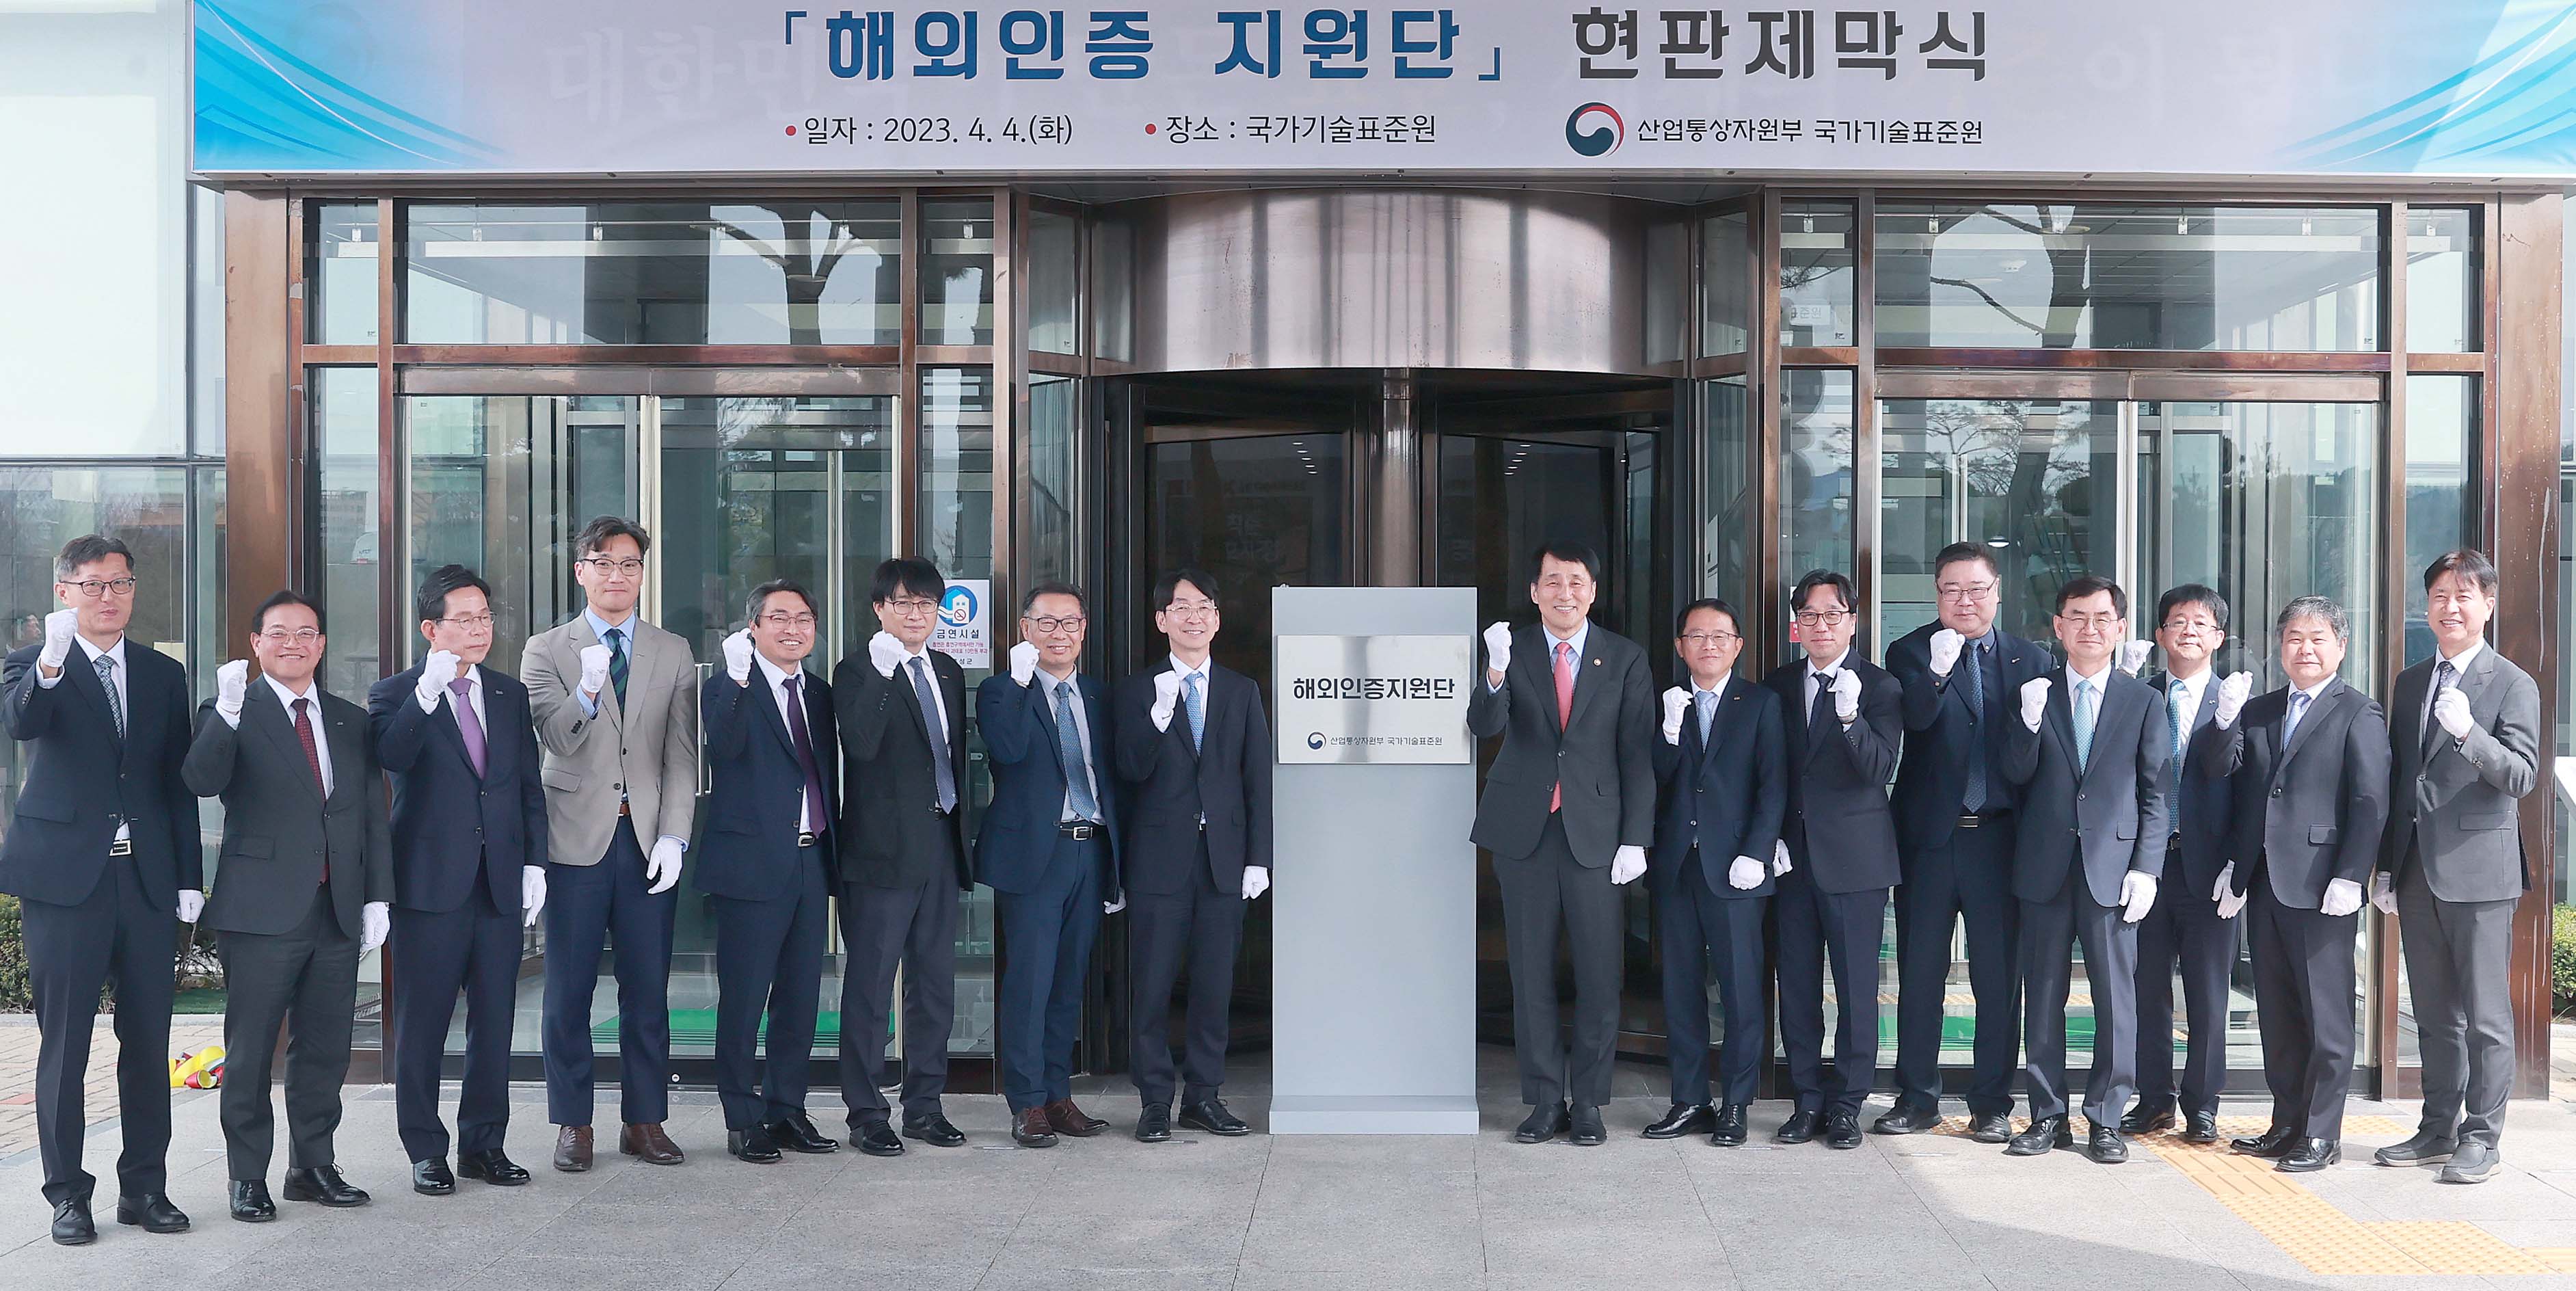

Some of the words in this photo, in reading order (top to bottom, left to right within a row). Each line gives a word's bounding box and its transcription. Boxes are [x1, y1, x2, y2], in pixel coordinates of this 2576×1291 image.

[1572, 6, 1985, 81] 현판제막식
[805, 117, 857, 145] 일자
[884, 118, 958, 143] 2023.
[968, 117, 992, 143] 4.
[1002, 114, 1072, 145] 4.(화)
[1166, 115, 1219, 144] 장소
[1246, 115, 1435, 144] 국가기술표준원
[1637, 118, 1803, 143] 산업통상자원부
[1814, 120, 1982, 144] 국가기술표준원
[937, 629, 979, 639] 금연시설
[1293, 678, 1455, 700] 해외인증지원단
[1330, 736, 1384, 746] 산업통상자원부
[1388, 737, 1443, 745] 국가기술표준원
